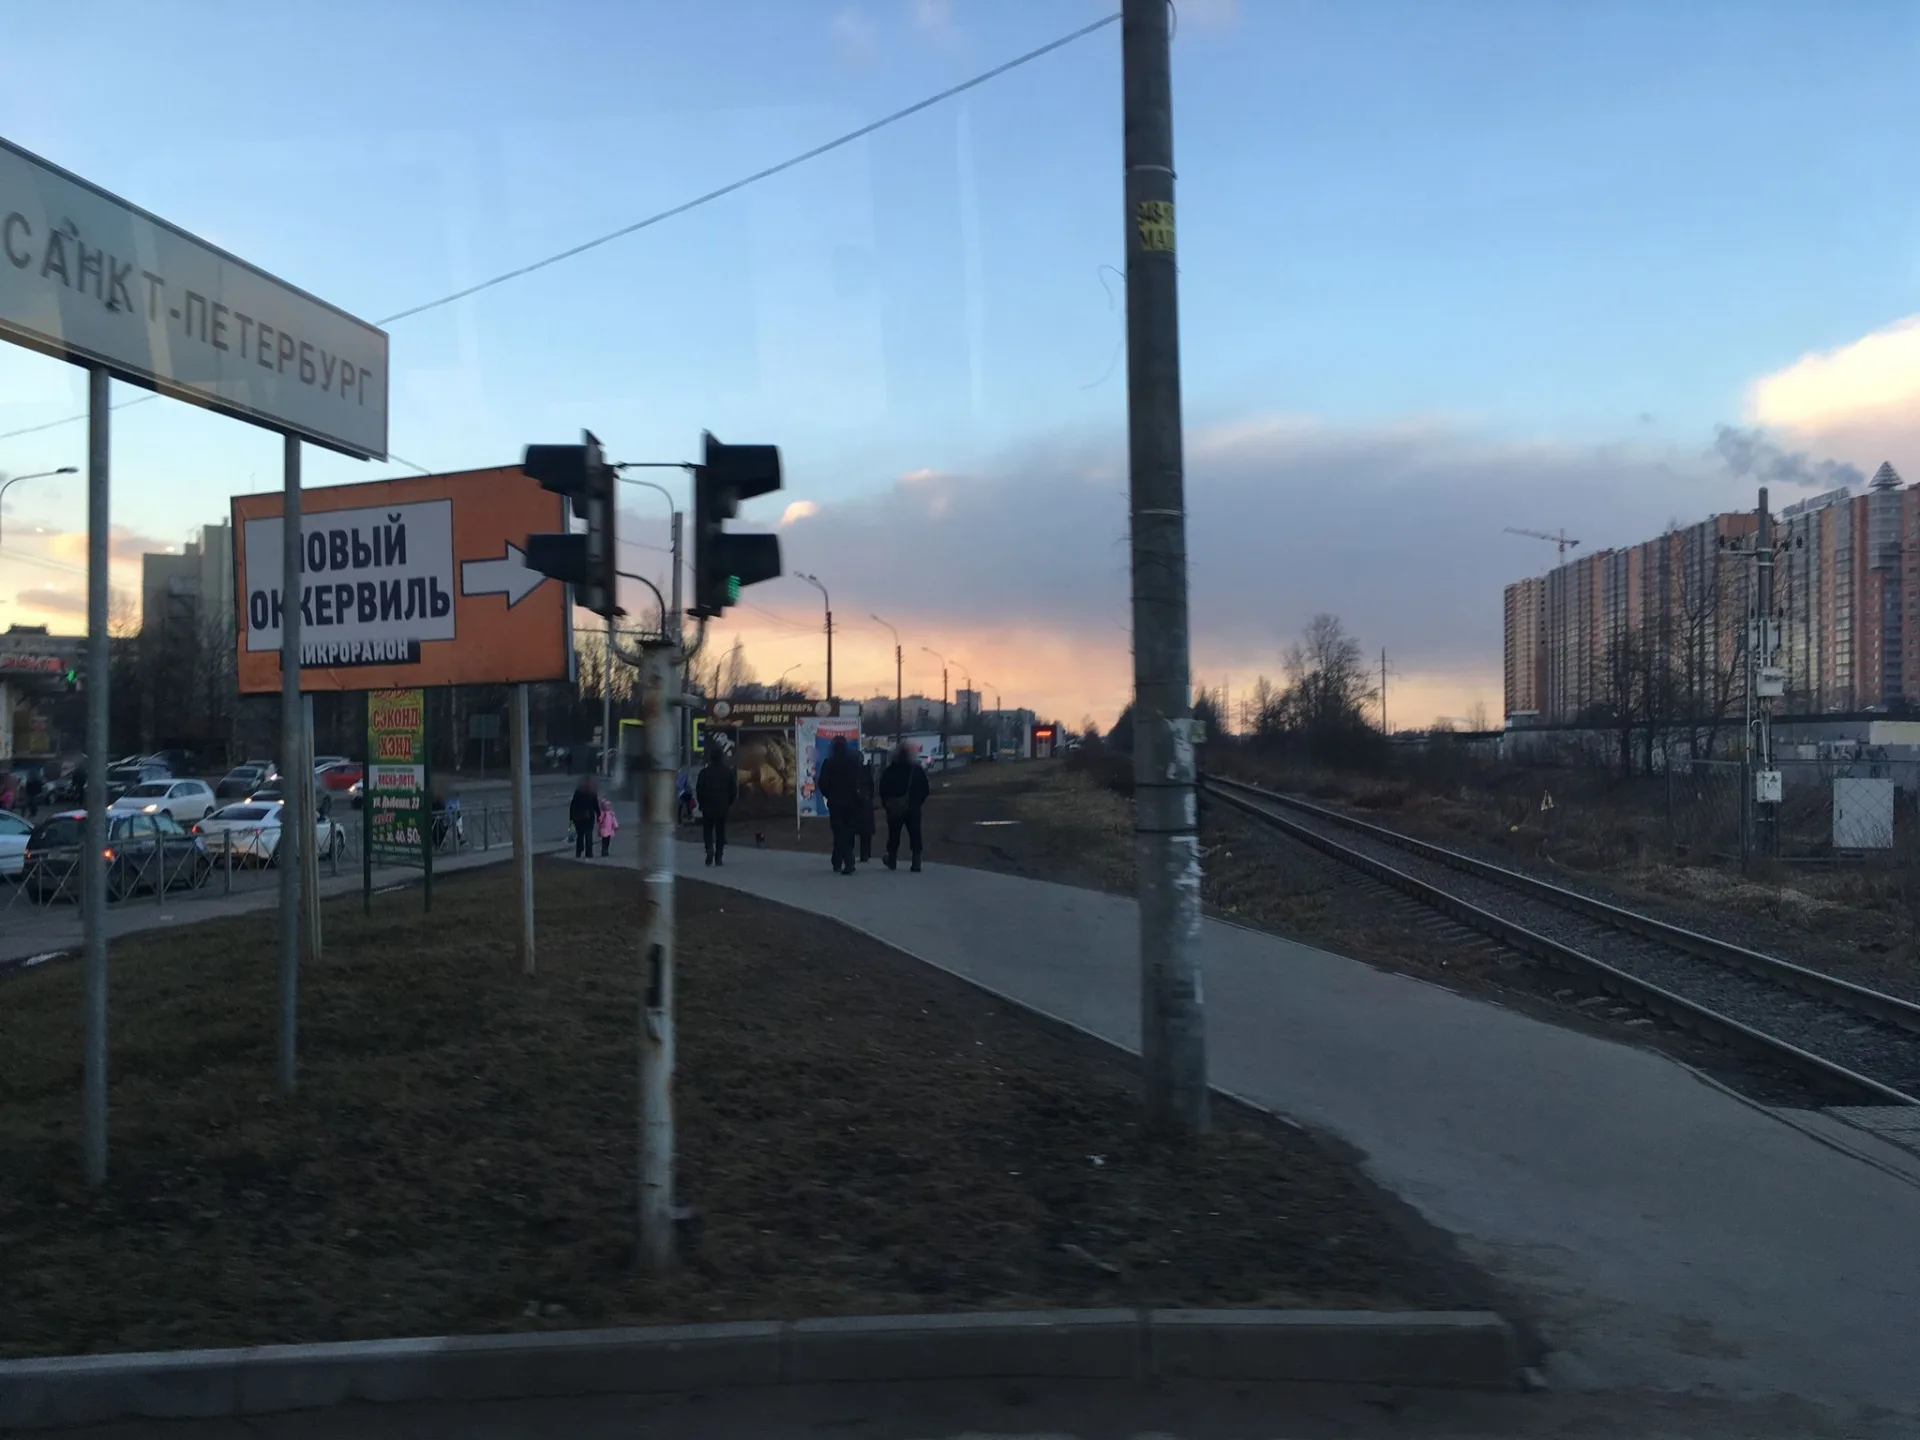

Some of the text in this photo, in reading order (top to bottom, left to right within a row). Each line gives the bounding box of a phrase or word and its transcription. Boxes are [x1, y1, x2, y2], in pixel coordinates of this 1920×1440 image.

[4, 211, 373, 406] САНКТ-ПЕТЕРБУРГ
[299, 637, 409, 665] ИКРОРАЙОН
[373, 707, 419, 730] СЭКОНД
[732, 703, 781, 714] ДОМАШНИЙ
[753, 714, 790, 724] ПИРОГИ
[380, 735, 412, 758] ХЭНД
